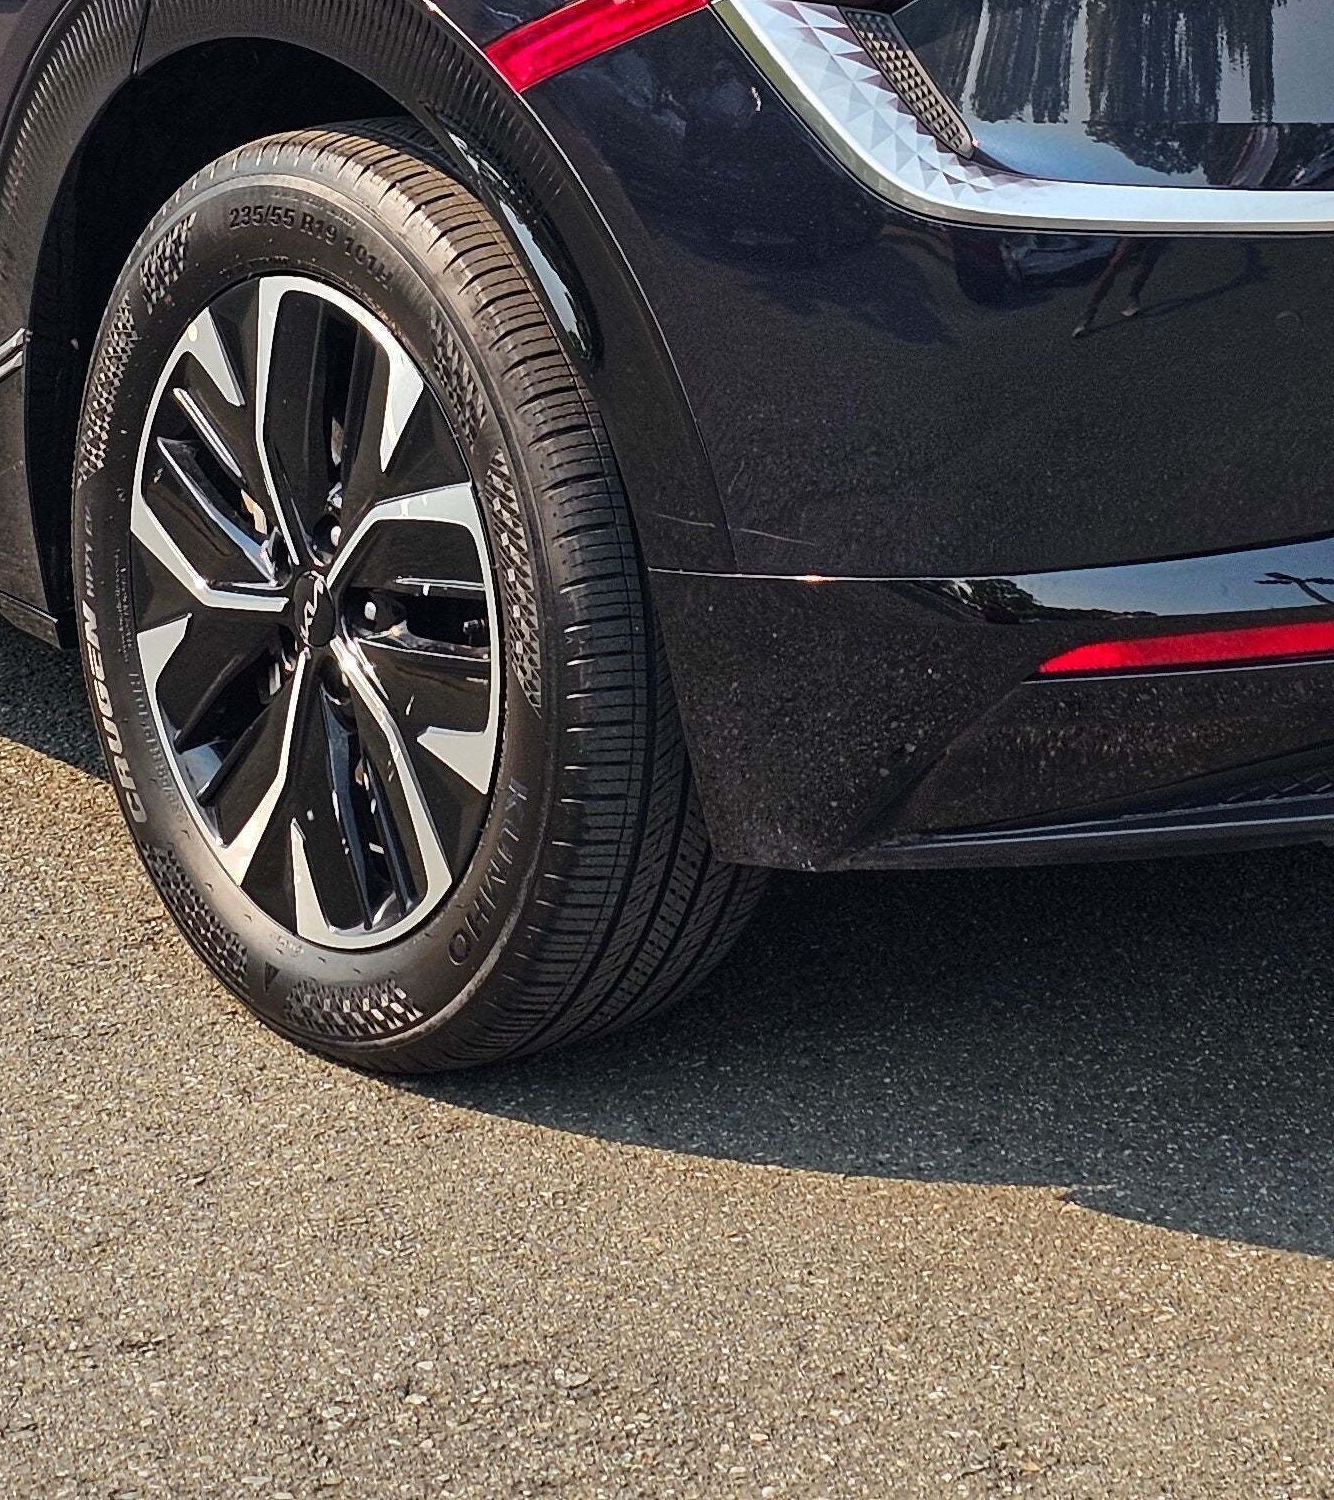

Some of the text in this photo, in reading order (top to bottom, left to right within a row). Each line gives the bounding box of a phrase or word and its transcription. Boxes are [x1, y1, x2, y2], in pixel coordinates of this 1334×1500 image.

[229, 204, 296, 231] 235/55
[300, 211, 340, 246] R19
[82, 599, 148, 823] CRUGEN
